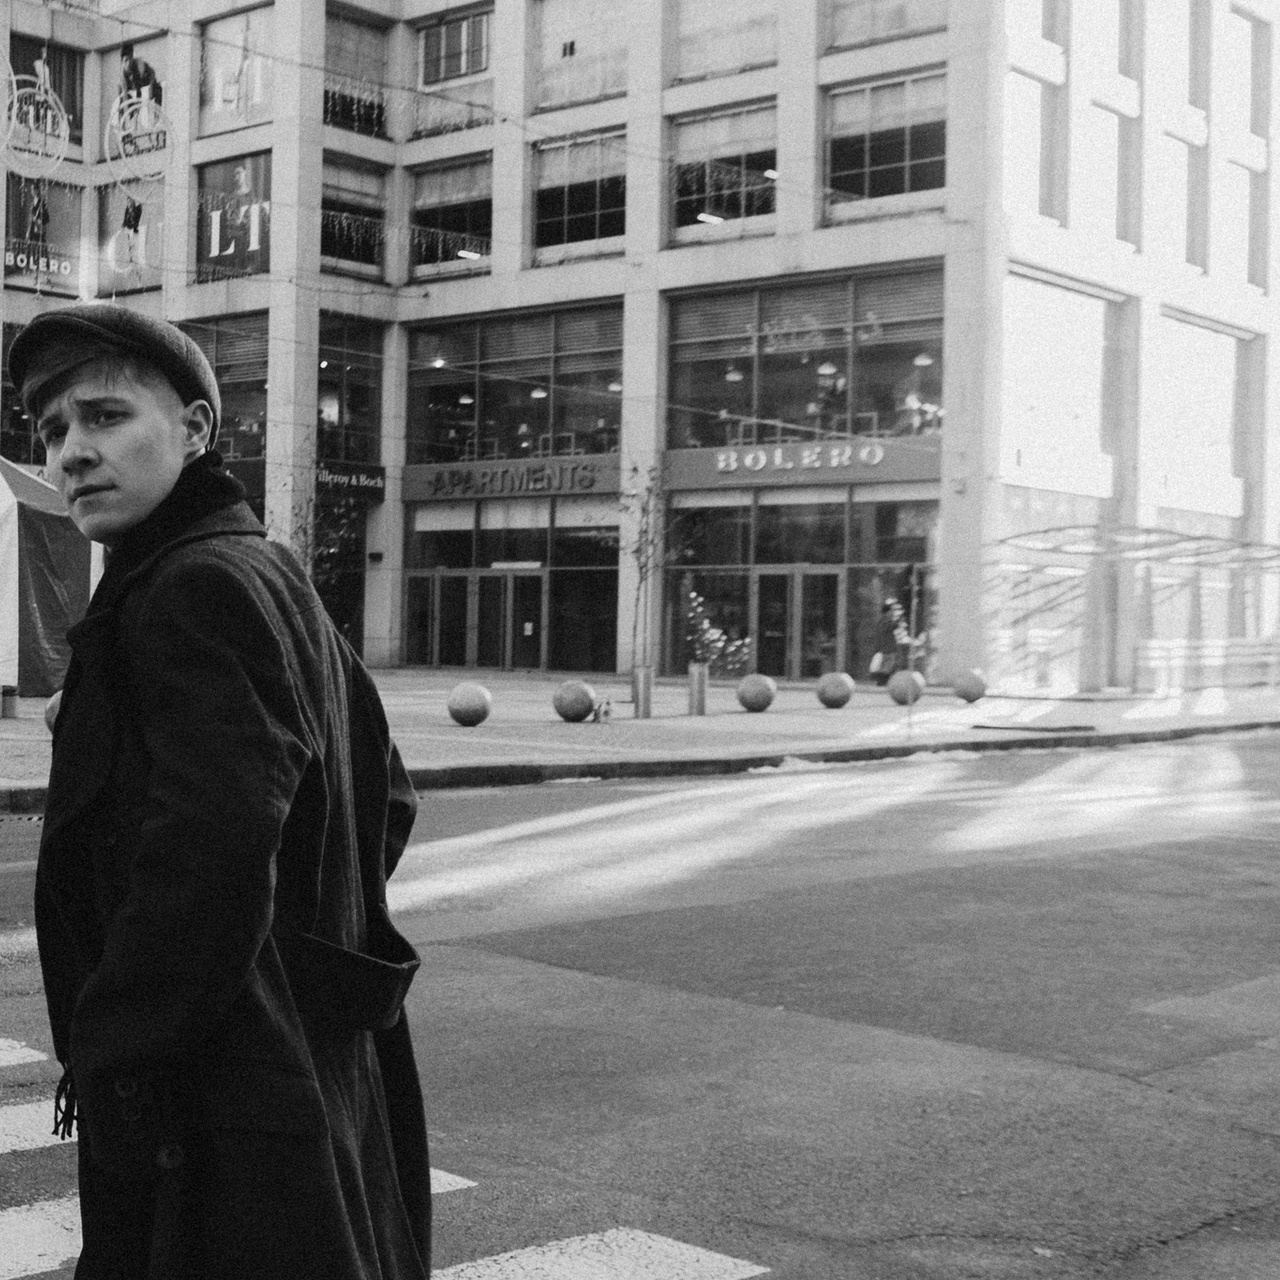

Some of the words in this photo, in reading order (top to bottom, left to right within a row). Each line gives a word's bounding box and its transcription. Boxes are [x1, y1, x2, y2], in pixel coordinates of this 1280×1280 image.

[5, 251, 72, 276] BOLERO
[717, 444, 885, 473] BOLERO
[428, 462, 598, 496] APARTMENTS
